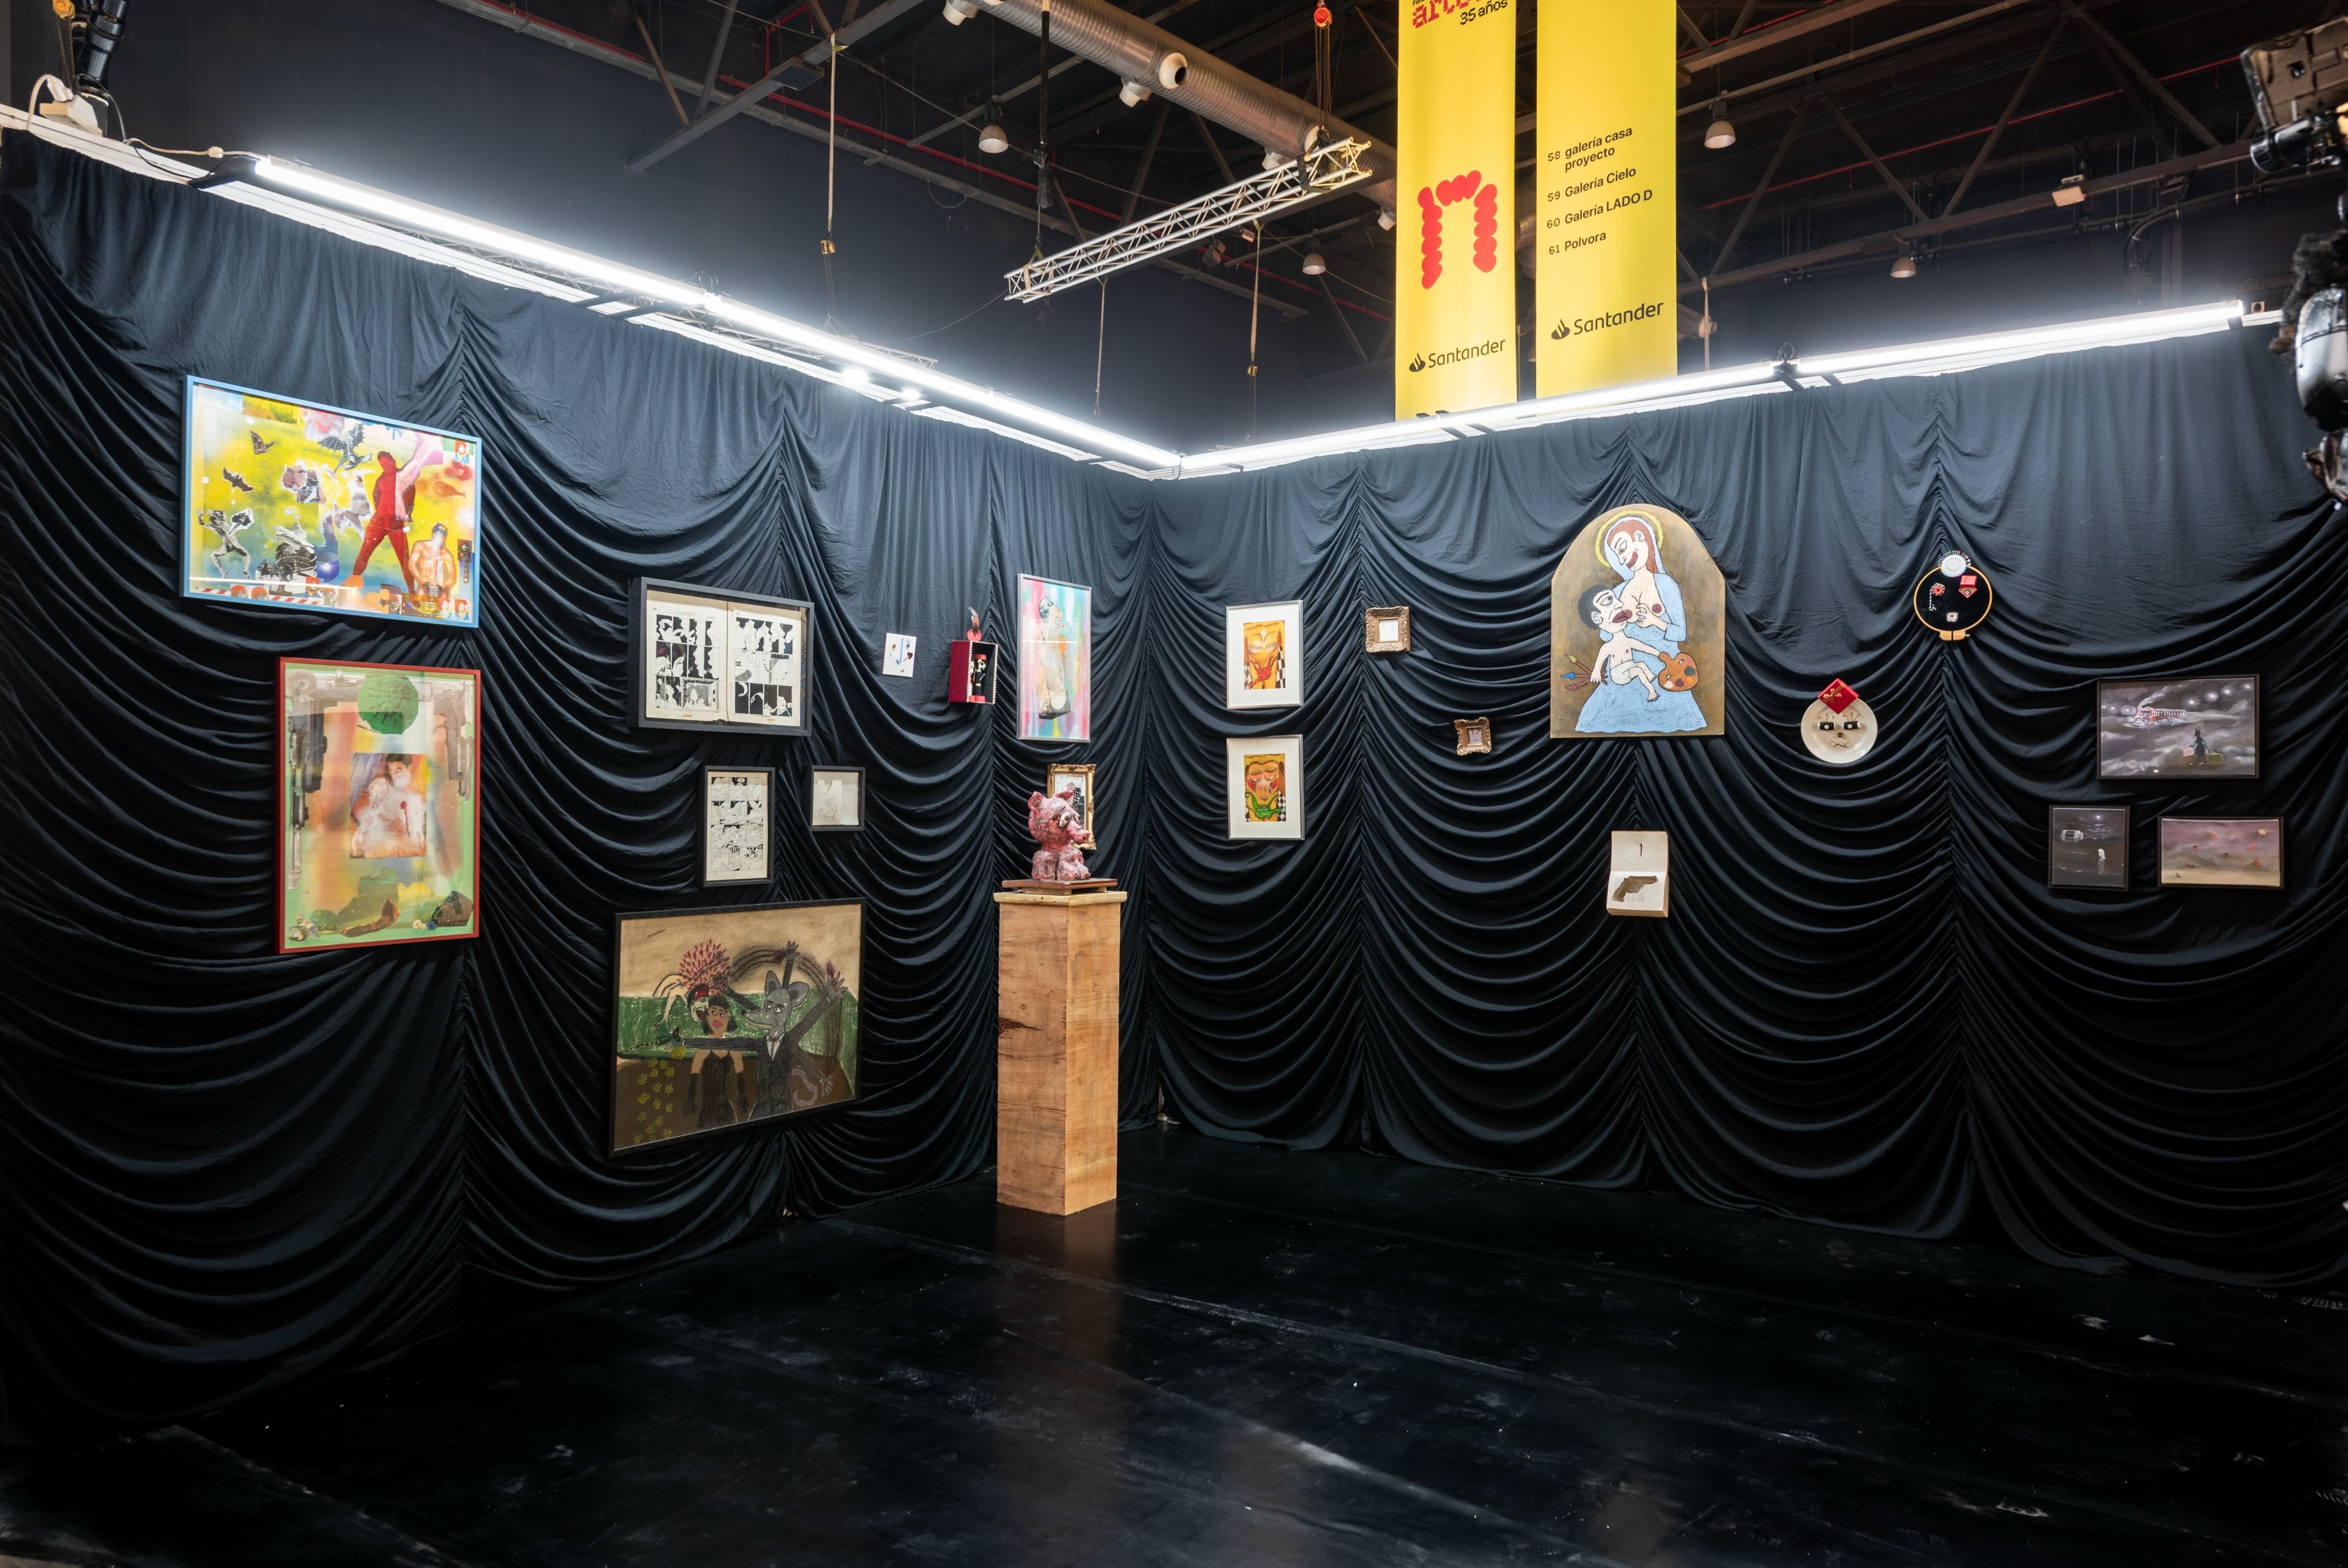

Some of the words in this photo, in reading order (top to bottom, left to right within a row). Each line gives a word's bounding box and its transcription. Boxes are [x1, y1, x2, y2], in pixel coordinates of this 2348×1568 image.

[1460, 7, 1476, 25] 35
[1478, 0, 1508, 17] años
[1548, 151, 1560, 162] 58
[1565, 136, 1602, 159] galería
[1605, 128, 1632, 143] casa
[1565, 147, 1615, 173] proyecto
[1548, 191, 1560, 202] 59
[1565, 177, 1603, 197] Galería
[1607, 167, 1636, 183] Cielo
[1547, 218, 1560, 228] 60
[1565, 204, 1603, 224] Galería
[1607, 193, 1640, 211] LADO
[1644, 190, 1653, 201] D
[1549, 245, 1560, 254] 61
[1565, 232, 1606, 251] Polvora
[1574, 302, 1664, 335] Santander
[1429, 340, 1505, 368] Santander
